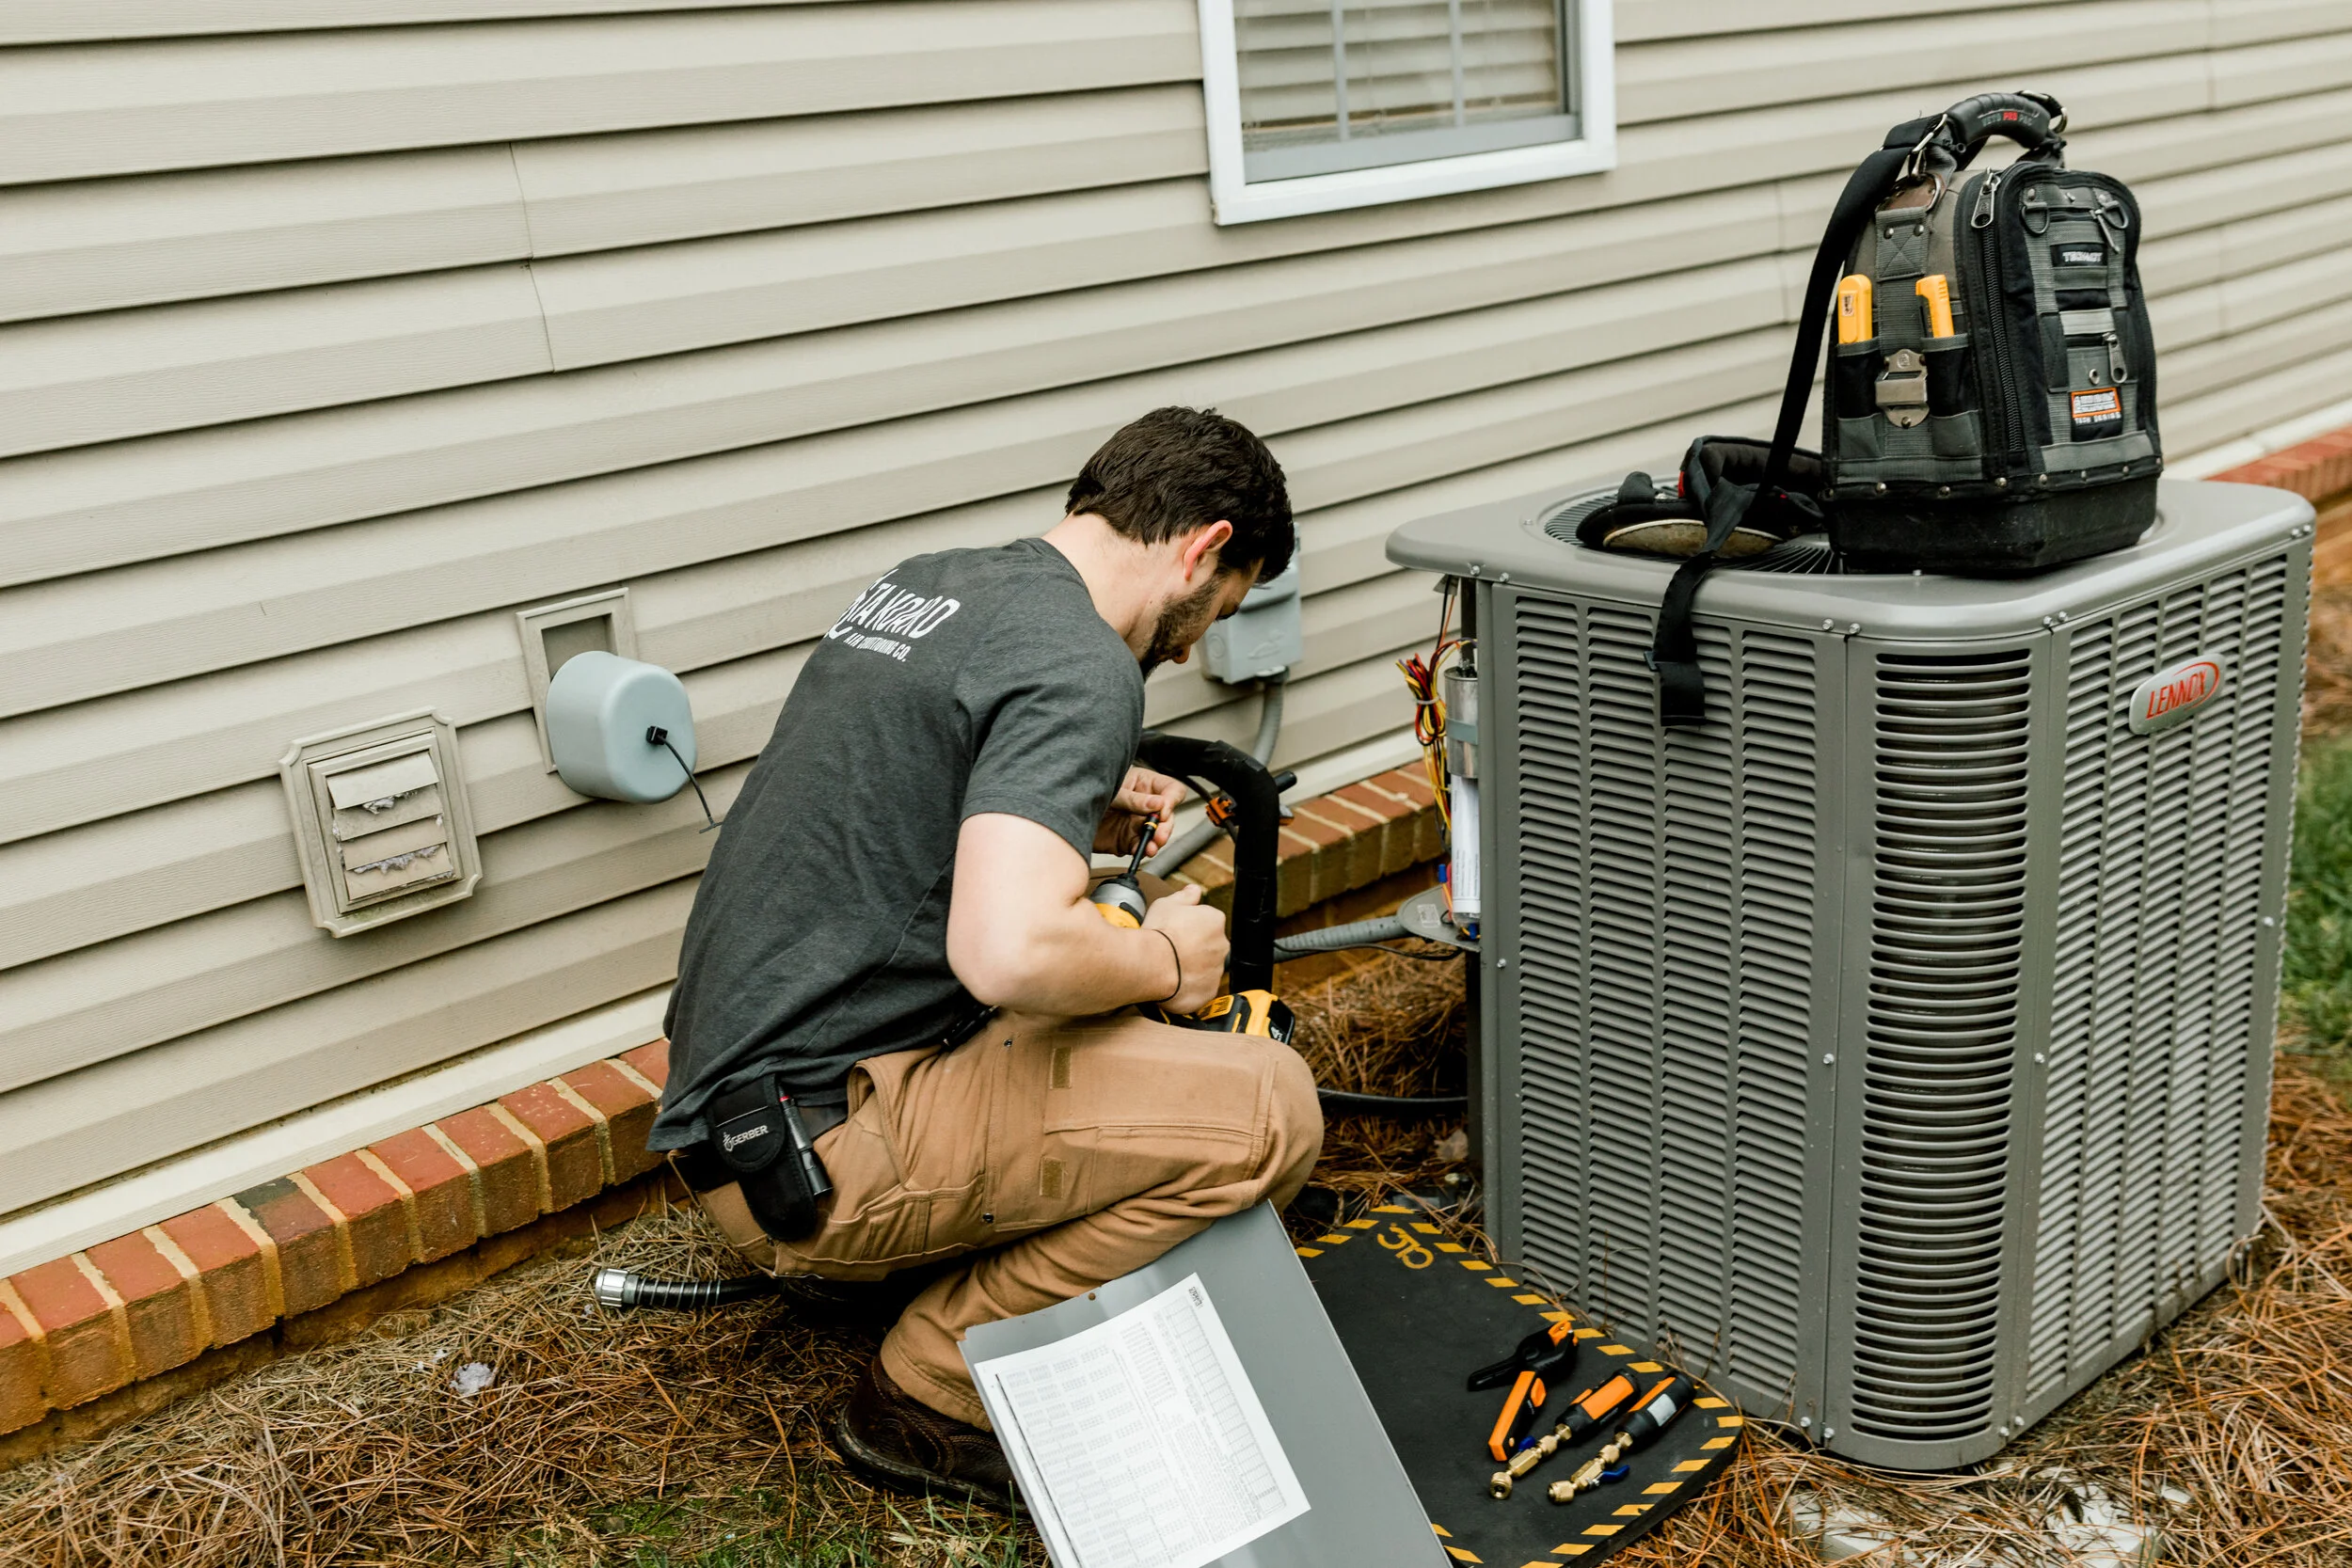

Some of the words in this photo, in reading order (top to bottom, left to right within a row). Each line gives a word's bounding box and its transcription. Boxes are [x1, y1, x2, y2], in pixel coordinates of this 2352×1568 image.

[2002, 110, 2018, 121] PRO
[843, 632, 866, 647] AIR
[892, 643, 912, 662] CO.
[2145, 669, 2207, 721] LENNOX
[732, 1125, 770, 1146] GERBER
